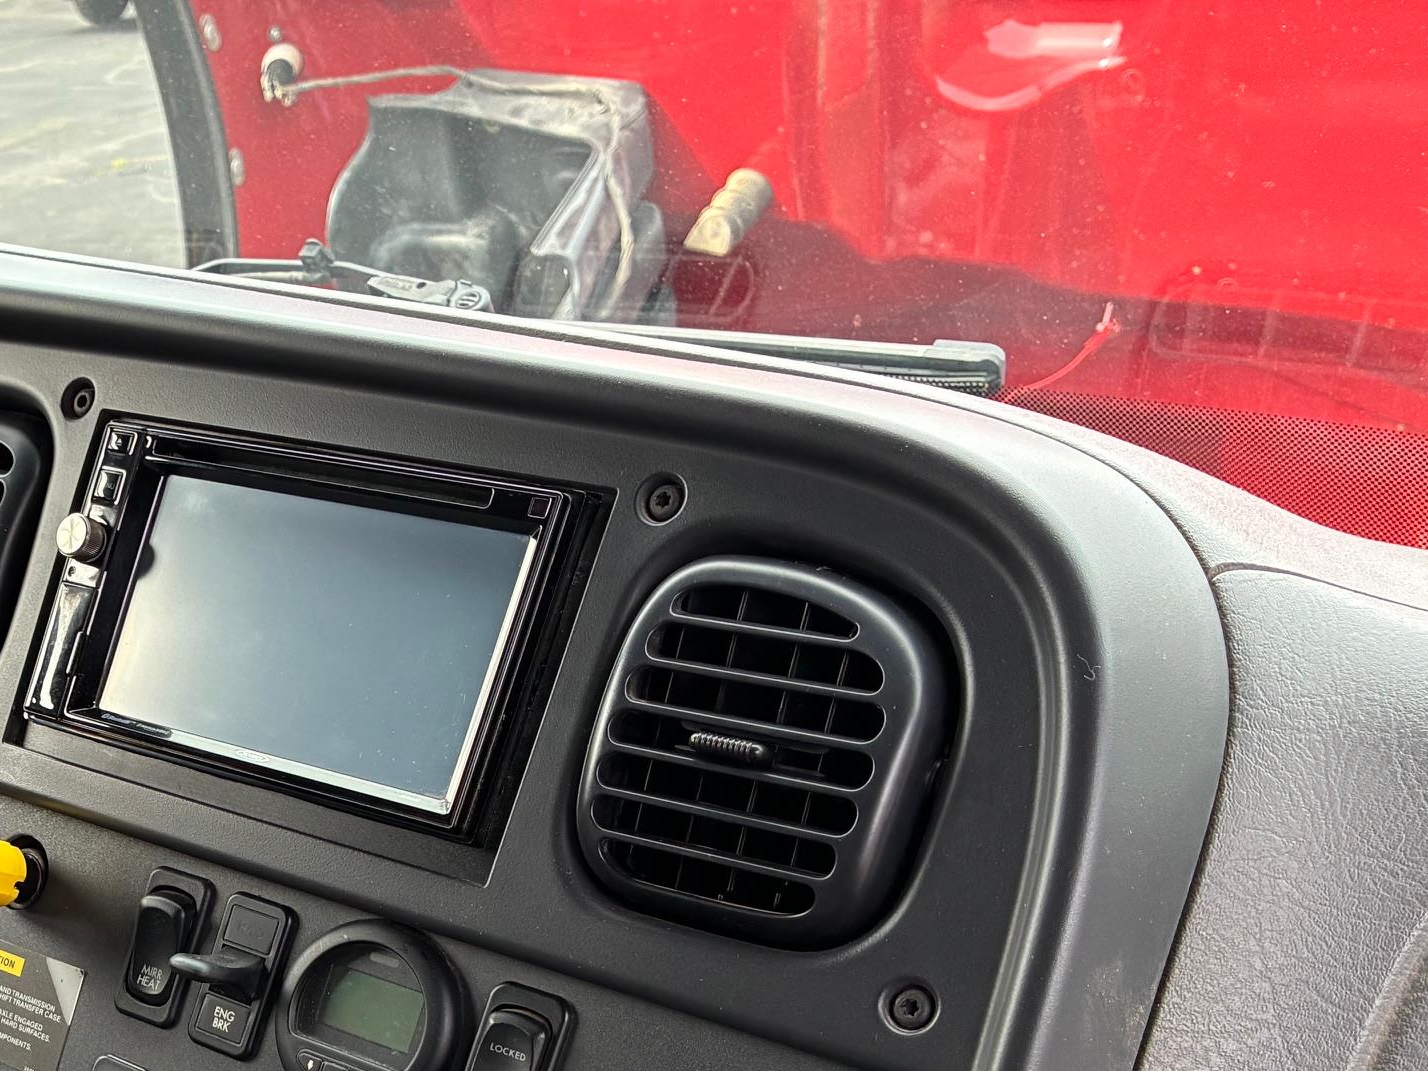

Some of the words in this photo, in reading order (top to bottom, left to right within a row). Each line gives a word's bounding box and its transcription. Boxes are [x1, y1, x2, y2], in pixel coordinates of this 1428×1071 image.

[141, 963, 163, 979] MIRR
[136, 975, 161, 990] HEAT
[12, 990, 55, 1011] TRANSMISSION
[13, 998, 44, 1015] TRANSFER
[44, 1011, 61, 1023] CASE
[213, 1006, 236, 1023] ENG
[1, 1017, 17, 1029] HARD
[18, 1025, 51, 1044] SURFACES.
[14, 1014, 43, 1031] ENGAGED
[212, 1017, 232, 1033] BRK
[489, 1042, 527, 1062] LOCKED
